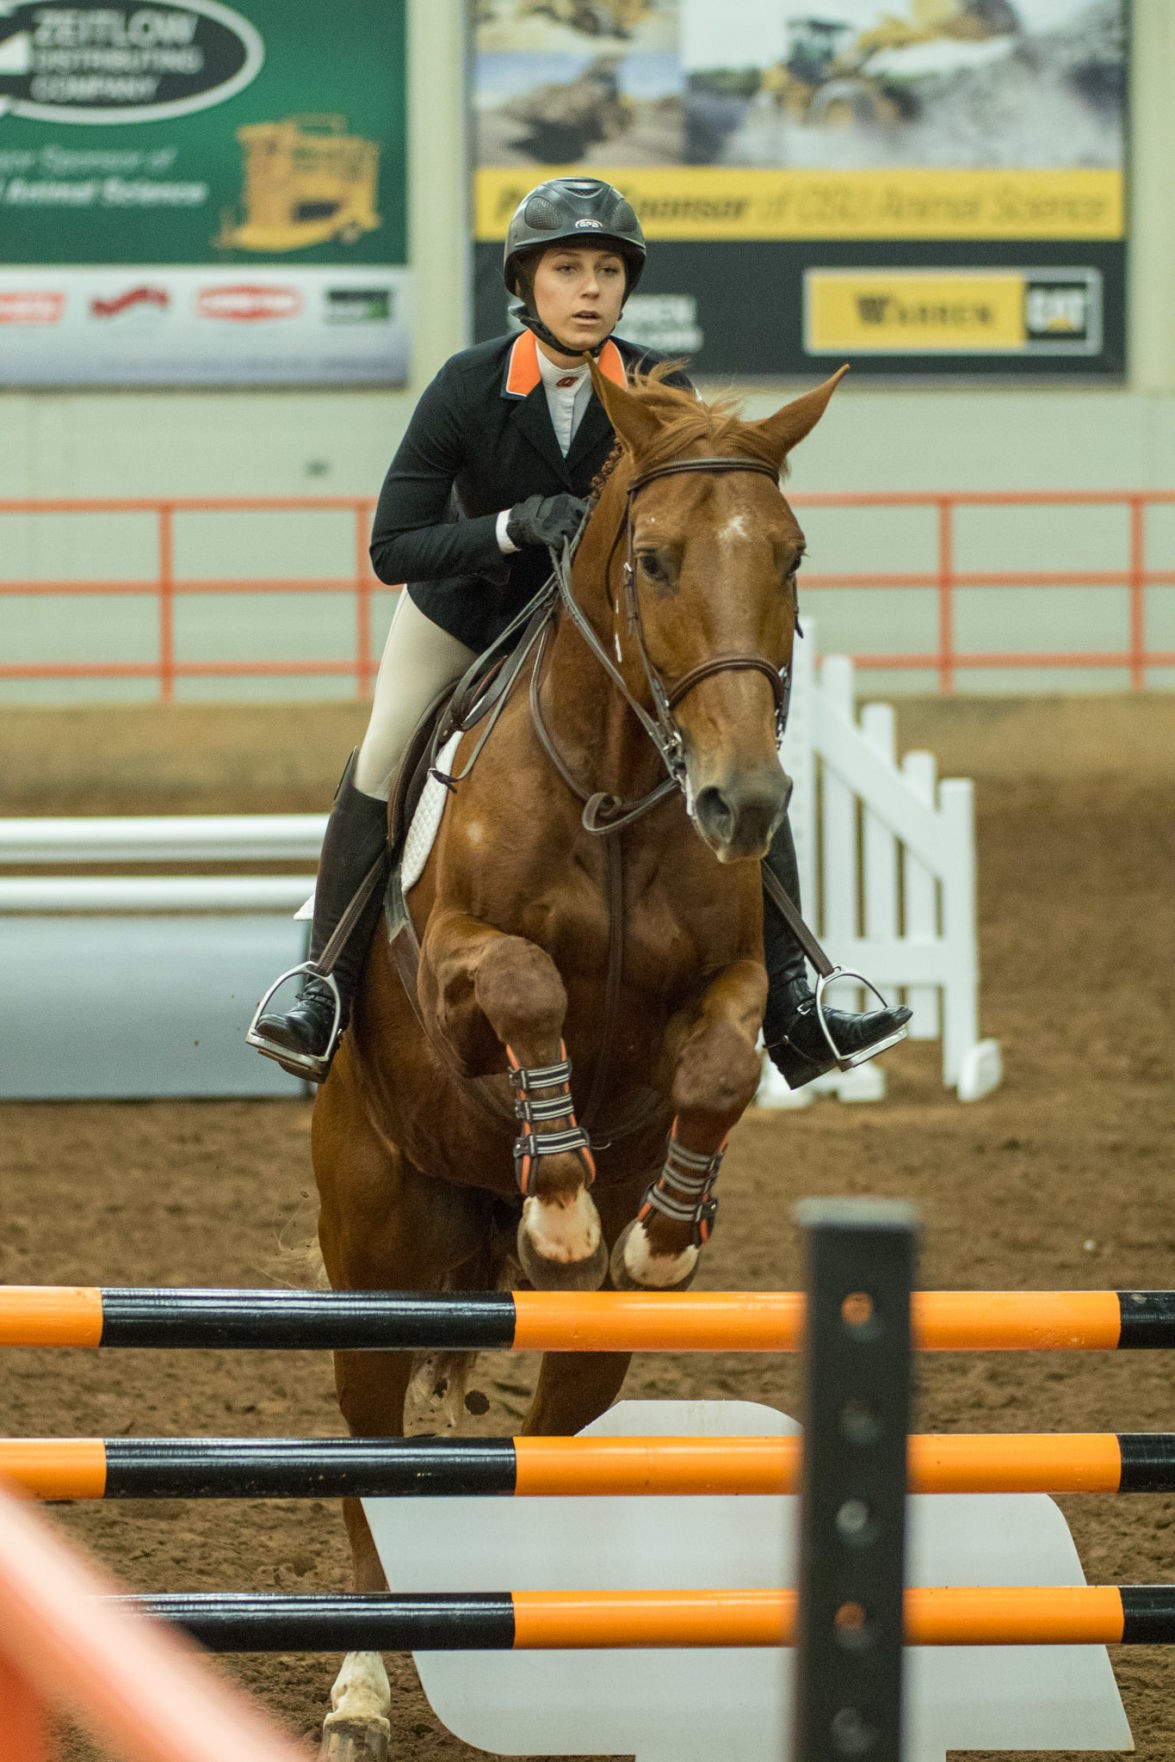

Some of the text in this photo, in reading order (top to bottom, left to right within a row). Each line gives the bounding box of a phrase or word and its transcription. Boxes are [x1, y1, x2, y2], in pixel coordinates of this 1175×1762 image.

[33, 9, 198, 47] ZEITLOW
[34, 47, 203, 74] DISTRIBUTING
[31, 75, 161, 101] COMPANY
[624, 187, 748, 223] ponsor
[1027, 288, 1085, 333] CAT
